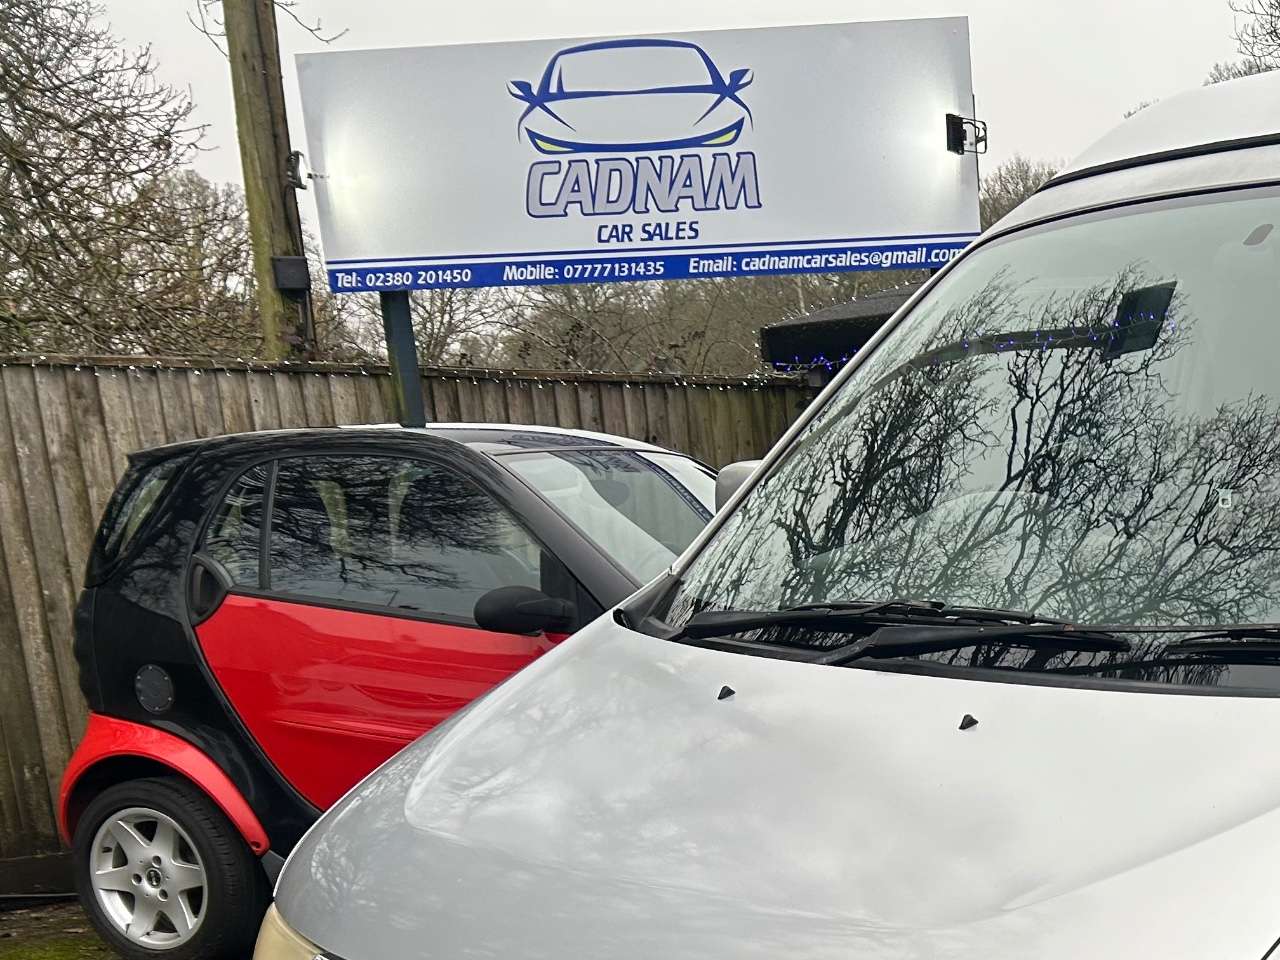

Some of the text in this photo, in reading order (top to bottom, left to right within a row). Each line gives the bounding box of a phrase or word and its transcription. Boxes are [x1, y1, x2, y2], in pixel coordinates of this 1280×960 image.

[526, 151, 762, 218] CADNAM
[597, 221, 699, 243] CAR SALES
[503, 261, 665, 281] Mobile: 07777131435
[689, 256, 737, 273] Email:
[336, 268, 472, 287] Tel: 02380 201450
